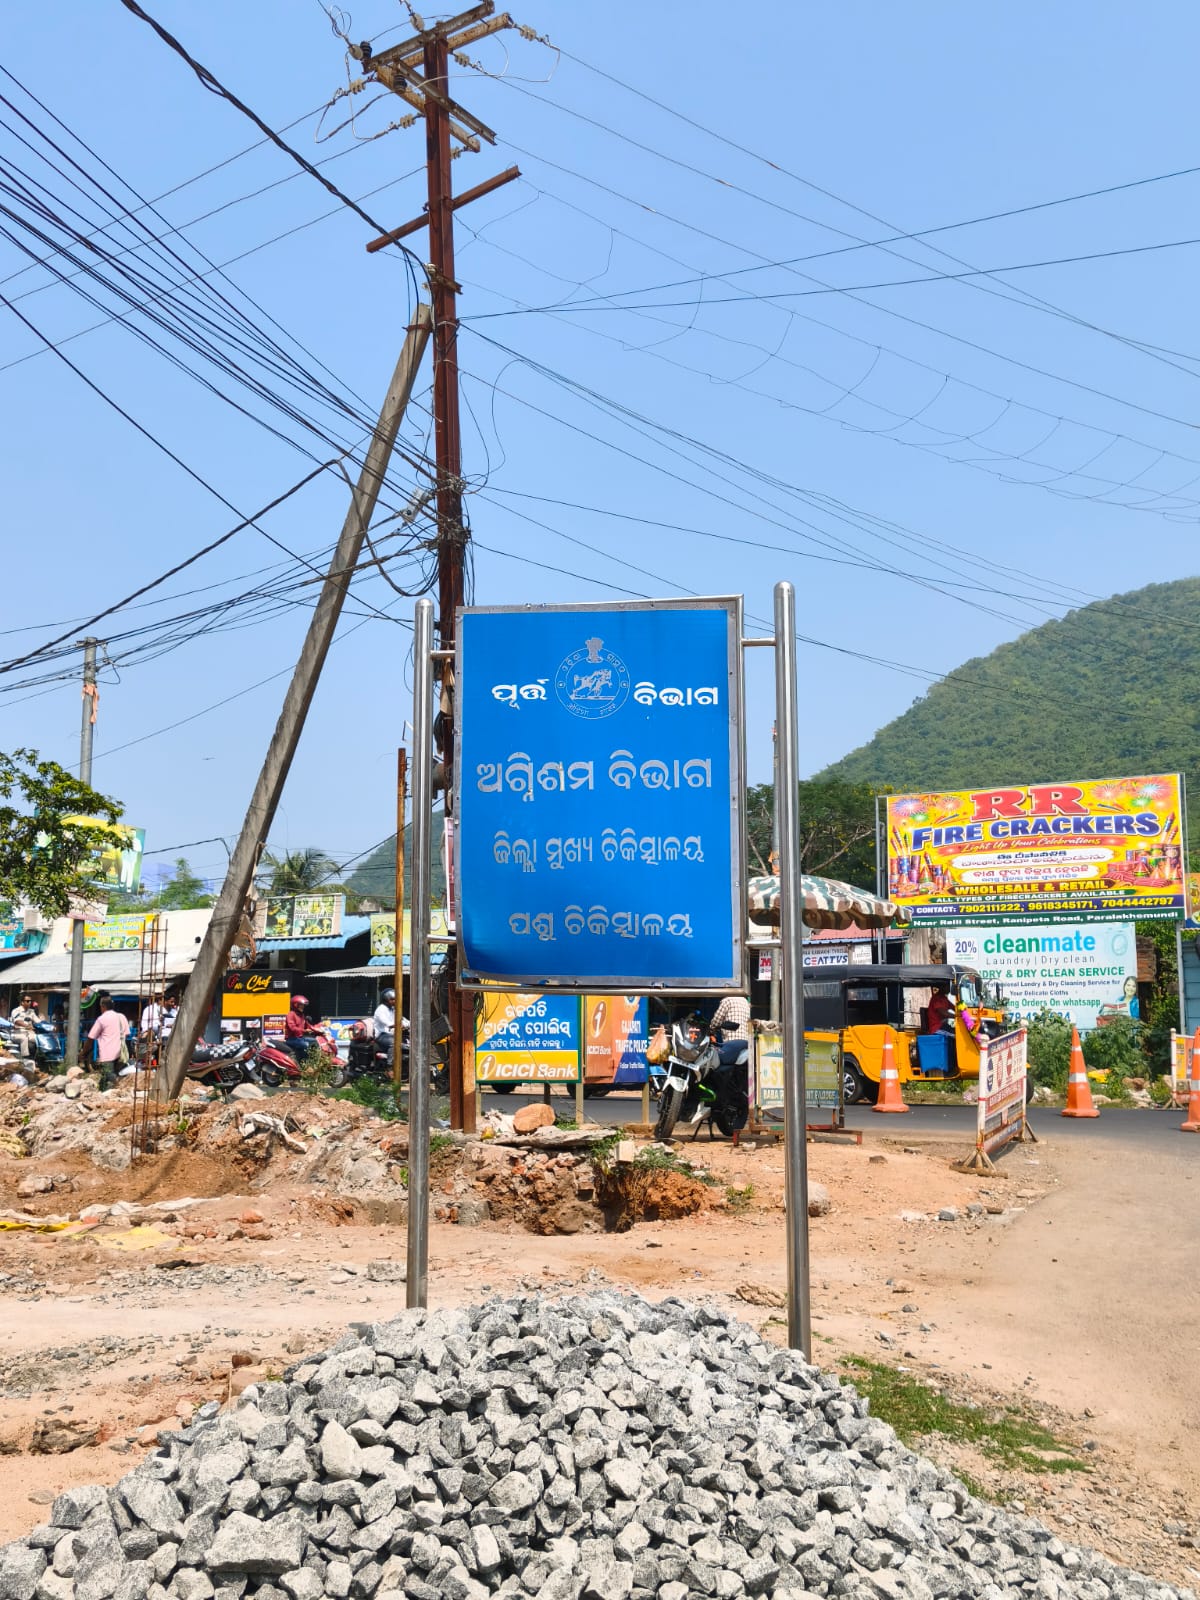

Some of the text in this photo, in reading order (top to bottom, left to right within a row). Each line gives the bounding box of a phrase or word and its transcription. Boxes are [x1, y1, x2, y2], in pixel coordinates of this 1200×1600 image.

[633, 681, 719, 707] ବିଭାଗ
[476, 749, 712, 803] ଅଗ୍ନିଶମ ବିଭାଗ
[970, 786, 1089, 822] RR
[911, 812, 1161, 851] FIRE CRACKERS
[493, 827, 705, 873] ଜିଲ୍ଲା ମୁଖ୍ୟ ଚିକିତ୍ସାଳୟ
[960, 835, 1101, 853] Light Up Your Celebrations
[955, 880, 1109, 895] WHOLESALE & RETAIL
[1001, 892, 1067, 900] FIRECRACKERS
[1070, 889, 1125, 898] AVAILABLE
[916, 906, 957, 914] CONTACT:
[508, 904, 694, 941] ପଶୁ ଚିକିତ୍ସାଳୟ
[1003, 915, 1050, 924] Ranipeta
[1053, 914, 1084, 923] Road,
[1087, 911, 1178, 921] Paralakhemundi
[955, 941, 977, 953] 20%
[983, 930, 1096, 954] cleanmate
[804, 956, 830, 967] CEAT
[986, 956, 1031, 966] Laundry
[1006, 969, 1013, 978] &
[1017, 968, 1037, 978] DRY
[1041, 967, 1075, 977] CLEAN
[1079, 966, 1125, 976] SERVICE
[1021, 998, 1047, 1007] Orders
[1050, 998, 1061, 1007] On
[1063, 997, 1100, 1007] whatsapp
[615, 1039, 633, 1053] TRAFFIC
[495, 1063, 536, 1077] ICICI
[537, 1063, 576, 1077] Bank
